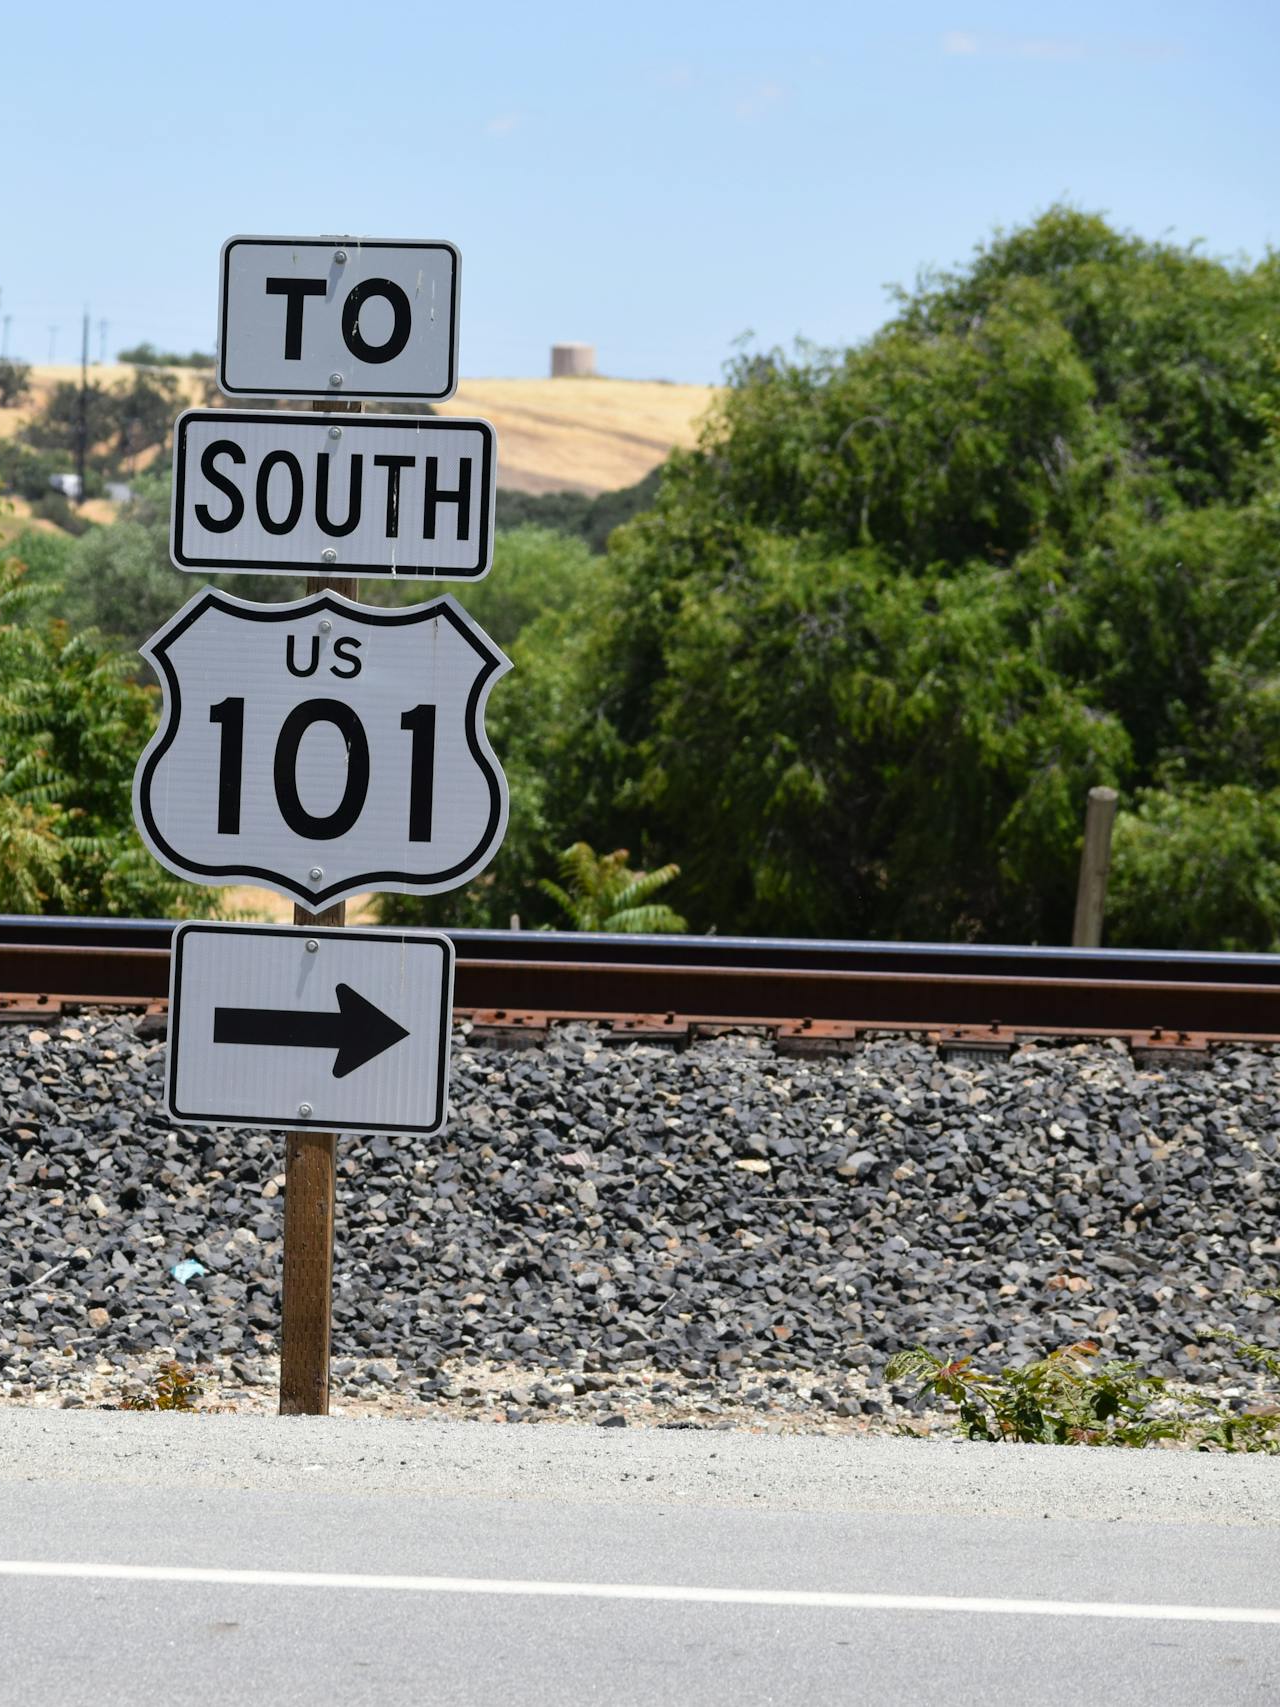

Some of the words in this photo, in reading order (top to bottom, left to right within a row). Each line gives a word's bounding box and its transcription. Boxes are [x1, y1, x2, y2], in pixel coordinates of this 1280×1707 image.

[266, 277, 412, 364] TO
[194, 439, 472, 541] SOUTH
[286, 634, 362, 679] US
[209, 697, 437, 843] 101
